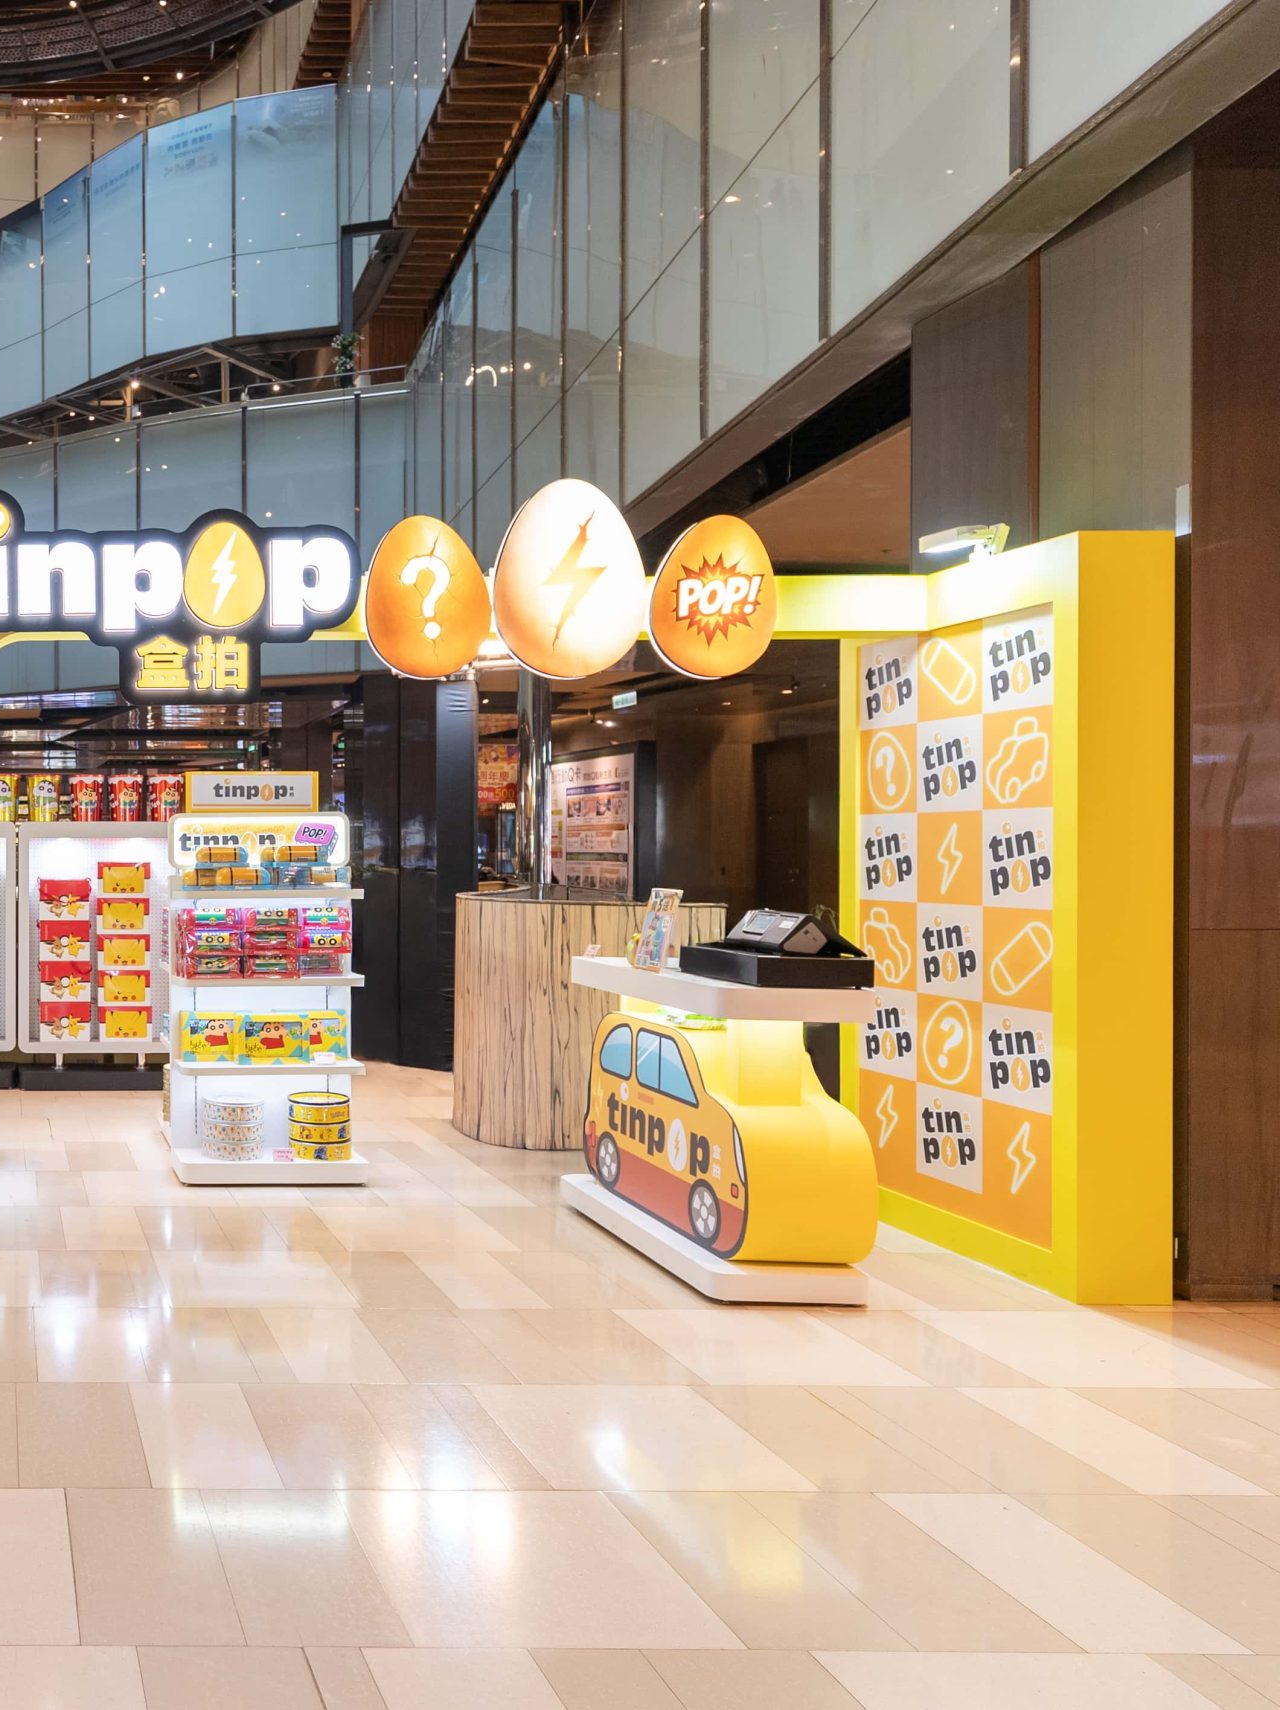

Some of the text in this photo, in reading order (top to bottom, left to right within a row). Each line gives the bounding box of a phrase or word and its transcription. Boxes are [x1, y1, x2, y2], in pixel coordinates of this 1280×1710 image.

[676, 573, 765, 621] POP!
[134, 634, 250, 693] 盒拍
[989, 627, 1036, 667] tin
[865, 655, 901, 690] tin
[990, 652, 1051, 701] pop
[866, 678, 912, 720] pop
[923, 732, 963, 770] tin
[213, 778, 289, 801] tinpop
[923, 760, 976, 801] pop
[301, 825, 327, 840] POP!
[865, 826, 900, 860] tin
[989, 822, 1036, 862] tin
[866, 855, 912, 890] pop
[990, 856, 1051, 896] pop
[922, 916, 963, 951] tin
[923, 950, 976, 983] pop
[865, 1031, 912, 1060] pop
[989, 1018, 1036, 1056] tin
[990, 1057, 1051, 1091] pop
[607, 1082, 710, 1177] tinpop
[922, 1099, 963, 1133] tin
[923, 1135, 976, 1168] pop
